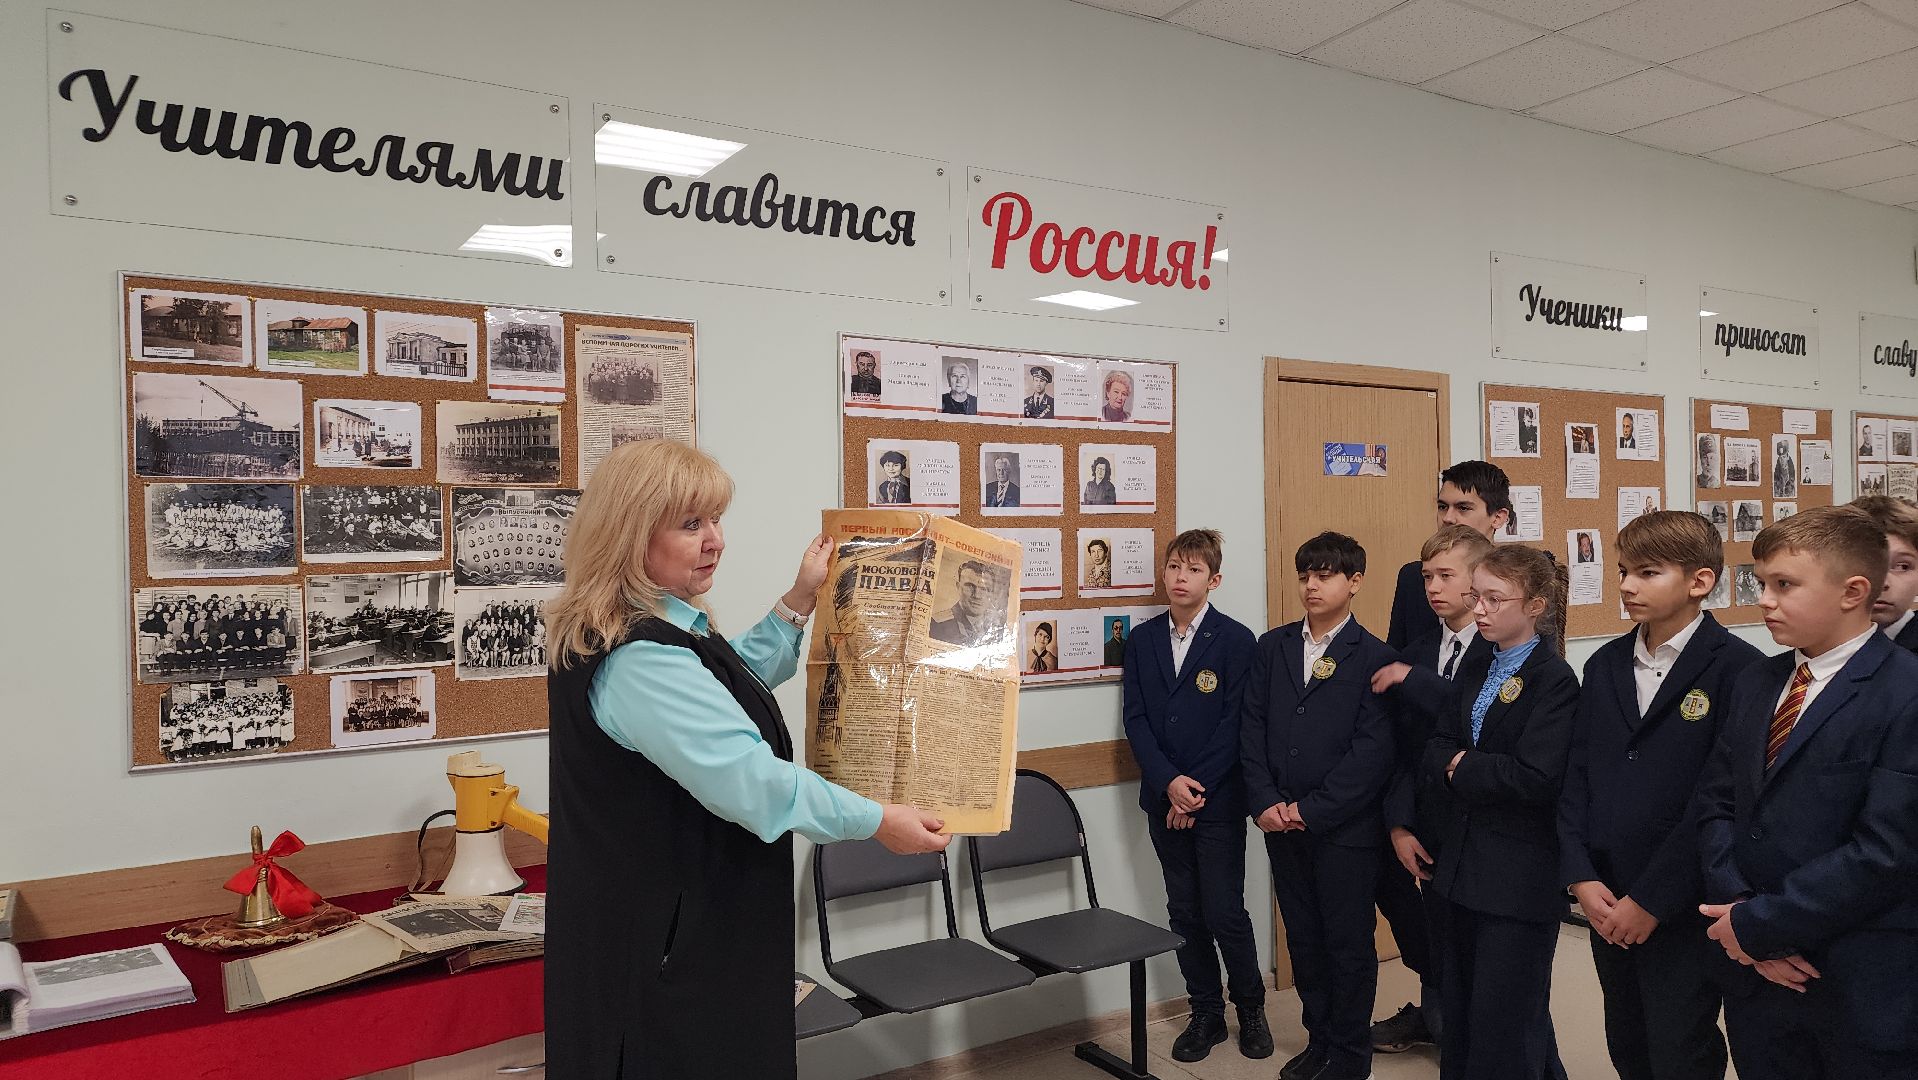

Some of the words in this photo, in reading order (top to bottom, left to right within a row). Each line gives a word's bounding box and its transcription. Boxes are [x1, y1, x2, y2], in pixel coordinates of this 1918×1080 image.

[58, 68, 565, 201] Учителями
[643, 172, 917, 247] славится
[982, 191, 1218, 291] Россия!
[1519, 283, 1624, 332] Ученики
[1714, 321, 1807, 357] приносят
[1874, 339, 1918, 378] славу
[1333, 454, 1381, 464] УЧИТЕЛЬСКАЯ
[841, 524, 887, 535] ПЕРВЫЙ
